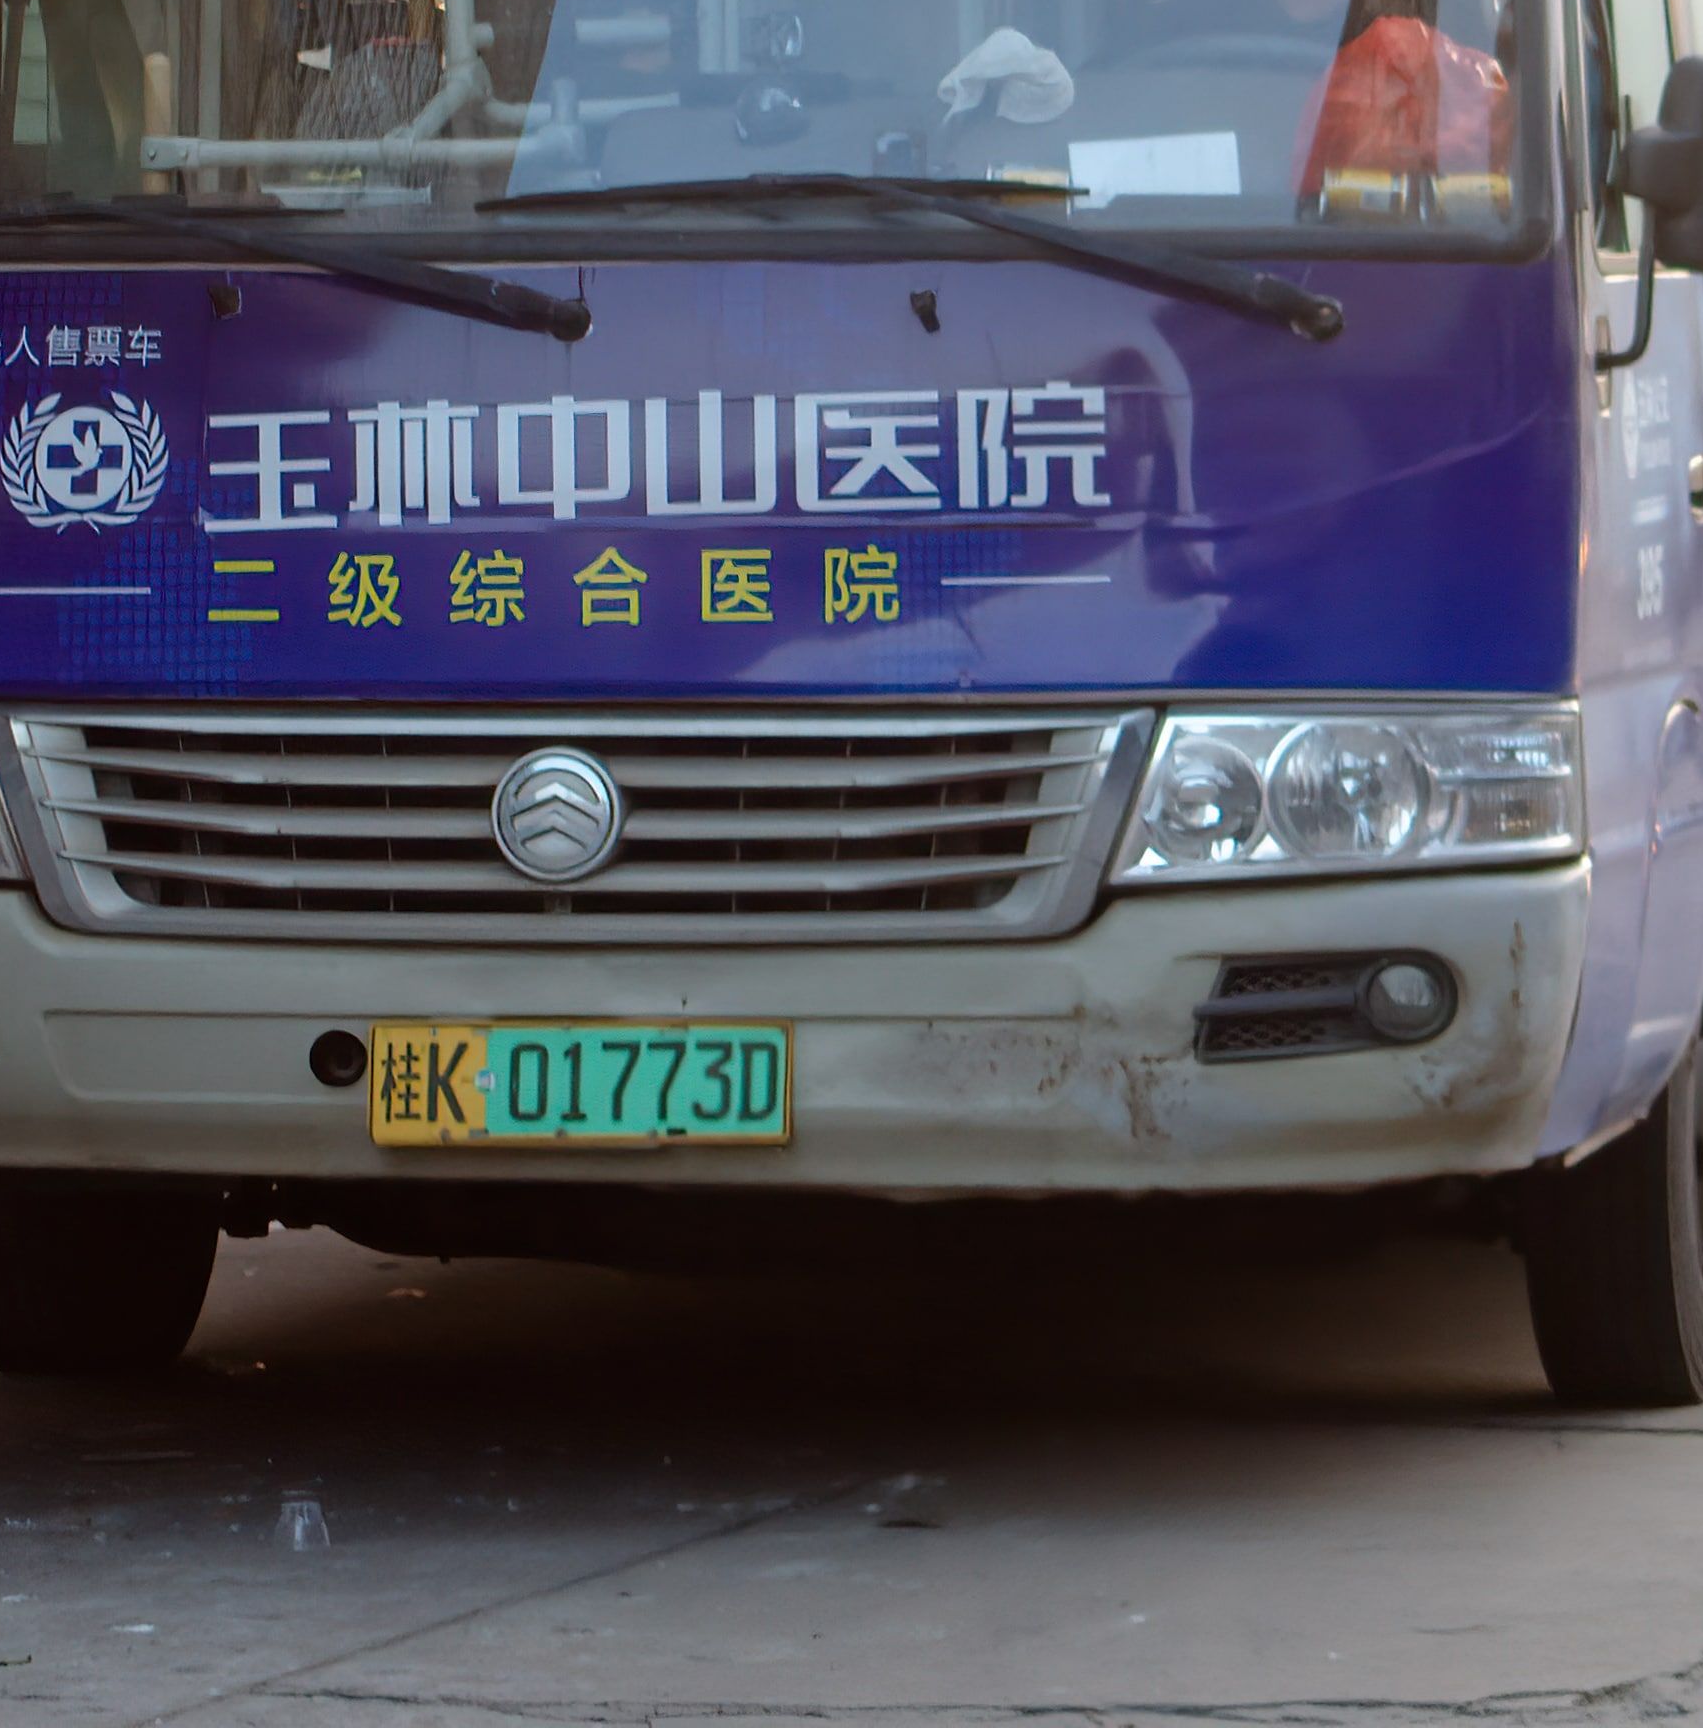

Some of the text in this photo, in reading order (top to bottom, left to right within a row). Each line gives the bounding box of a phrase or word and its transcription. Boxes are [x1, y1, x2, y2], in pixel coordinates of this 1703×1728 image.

[204, 380, 1112, 534] 玉林中山医院
[209, 546, 902, 626] 二级综合医院
